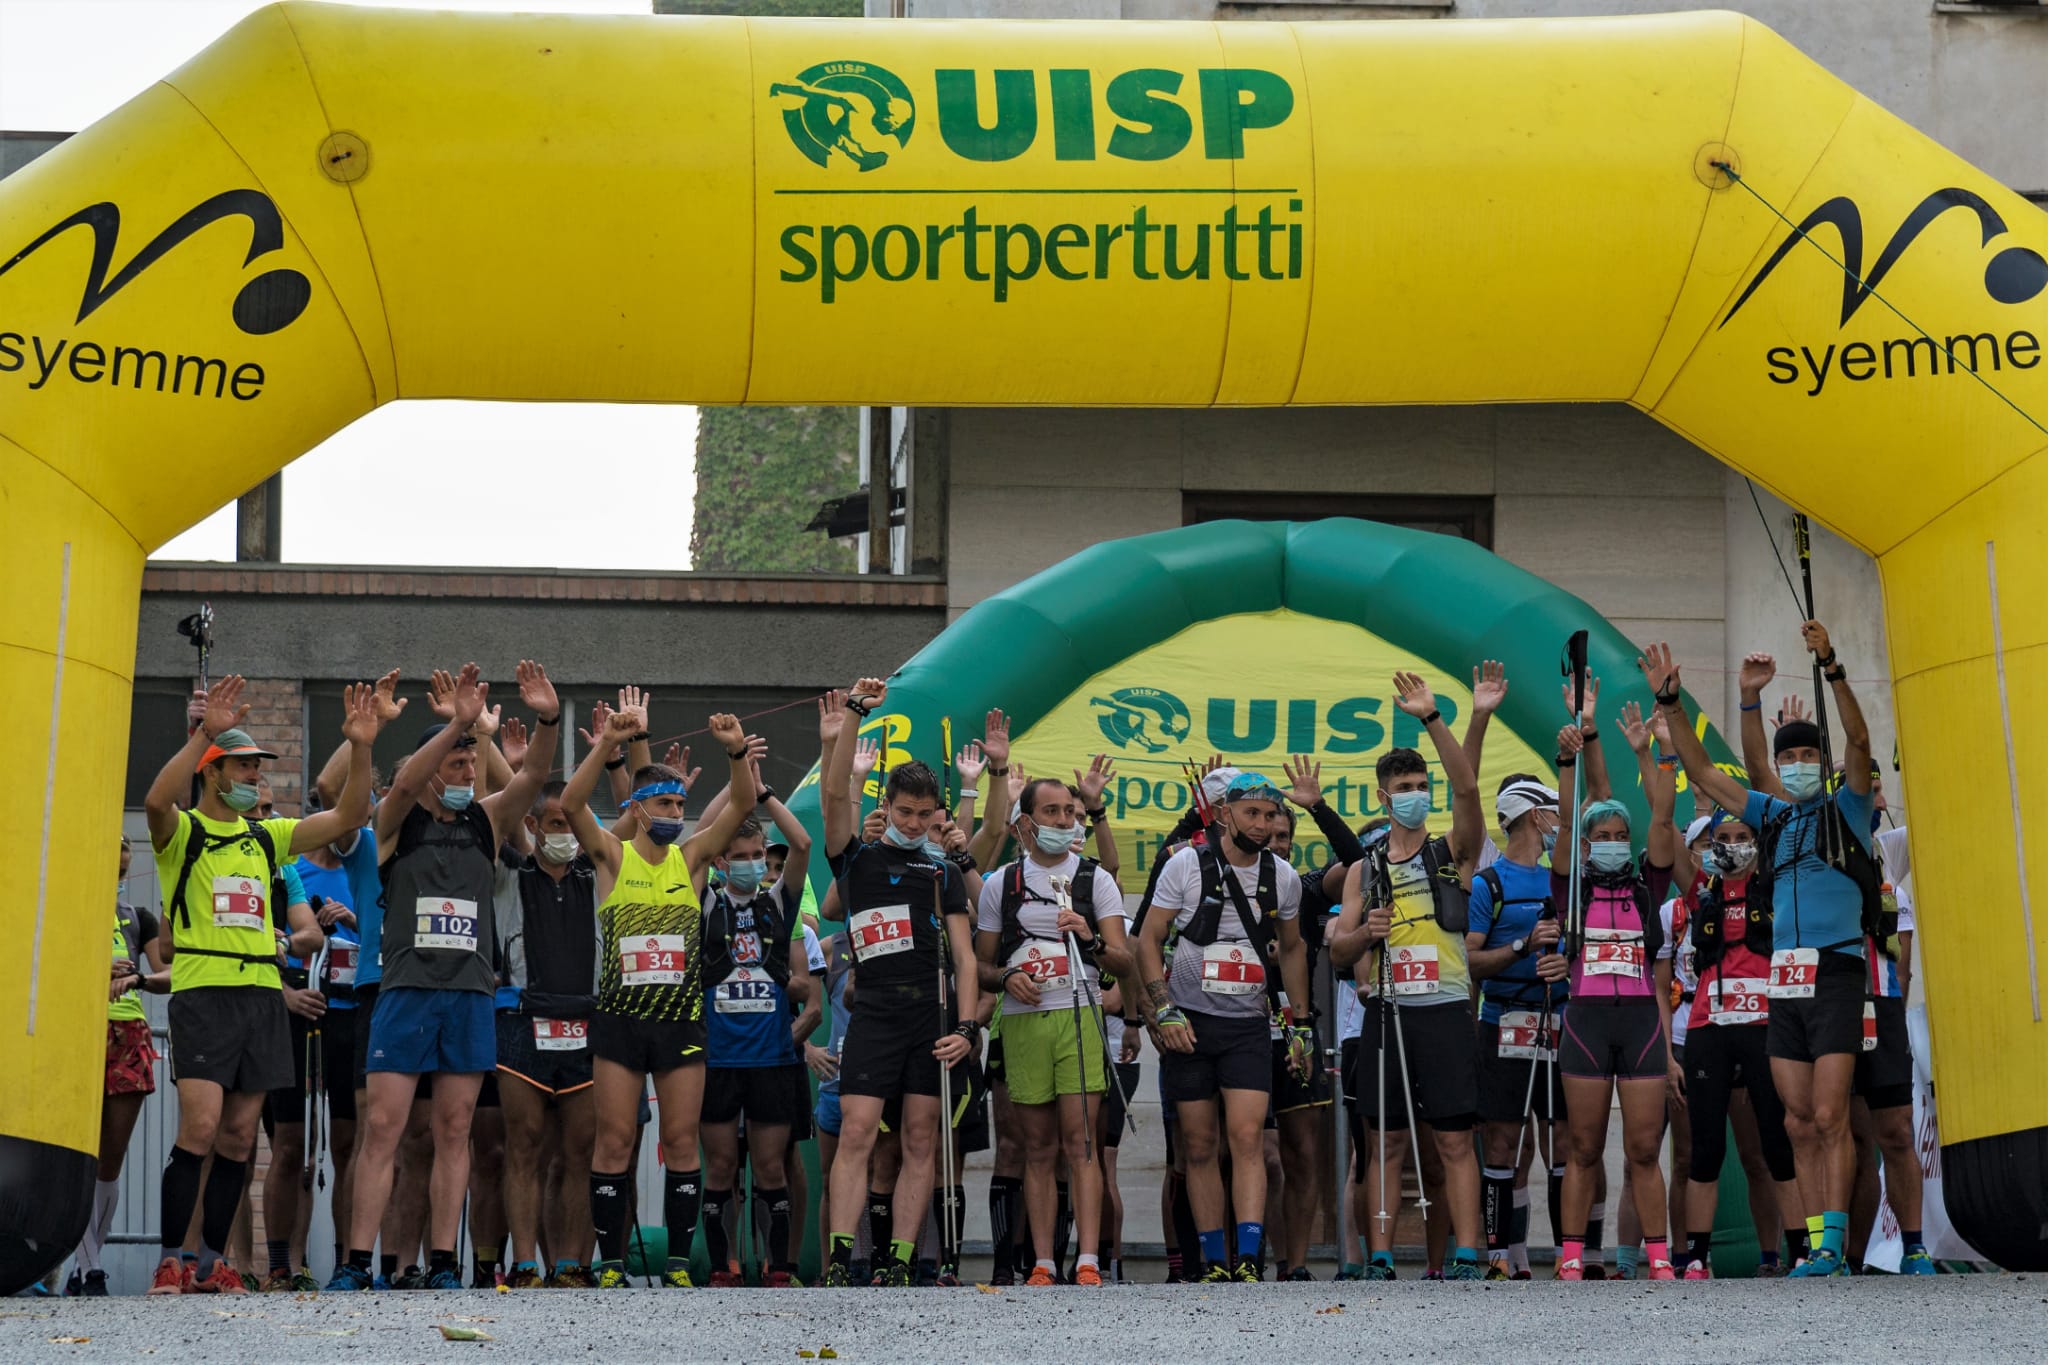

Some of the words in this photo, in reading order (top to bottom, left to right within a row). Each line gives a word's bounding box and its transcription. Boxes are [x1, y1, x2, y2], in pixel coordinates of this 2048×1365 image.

[824, 63, 866, 74] UISP
[934, 67, 1295, 163] UISP
[779, 198, 1303, 304] sportpertutti
[0, 331, 266, 401] syemme
[1766, 329, 2041, 397] syemme
[1131, 688, 1161, 697] UISP
[1206, 693, 1458, 754] UISP
[247, 896, 259, 913] 9
[438, 916, 473, 936] 102
[874, 922, 900, 941] 14
[648, 952, 674, 969] 34
[1610, 944, 1633, 962] 23
[1031, 959, 1057, 977] 22
[1238, 964, 1247, 981] 1
[1402, 963, 1427, 981] 12
[1786, 966, 1806, 984] 24
[735, 982, 771, 998] 112
[1734, 994, 1760, 1011] 26
[561, 1021, 585, 1037] 36
